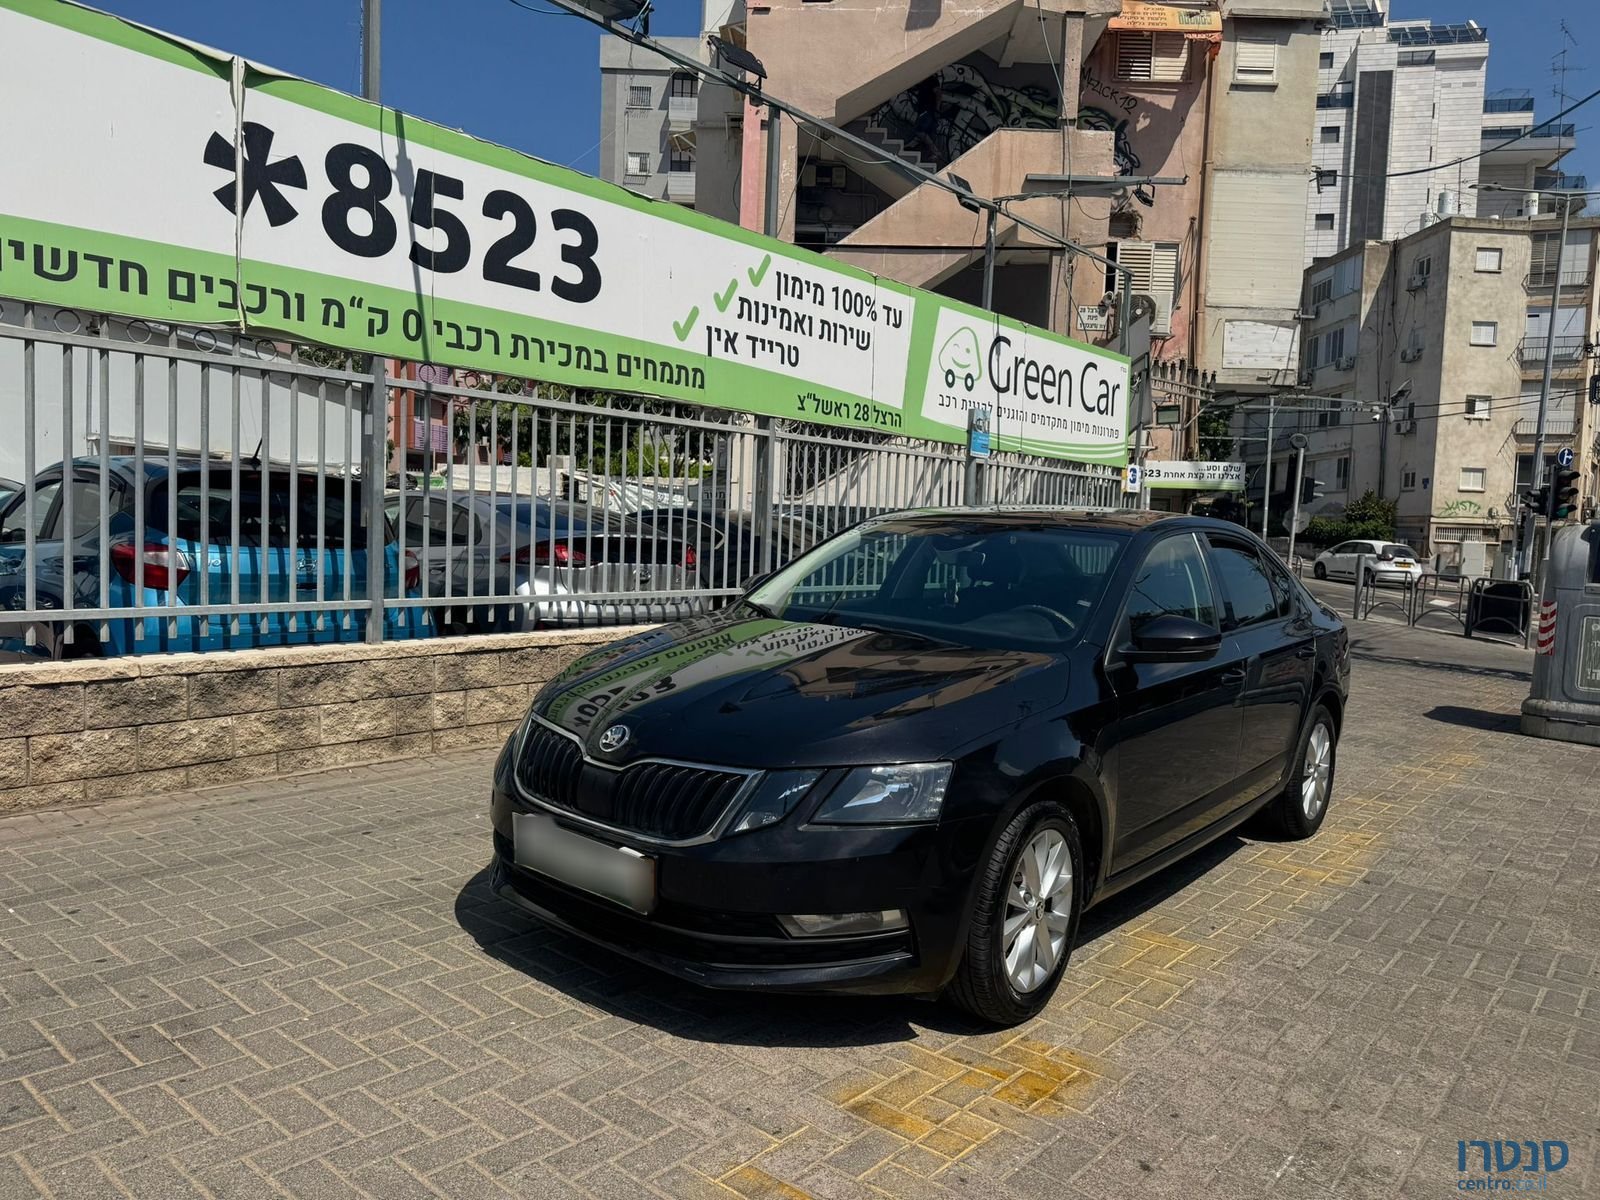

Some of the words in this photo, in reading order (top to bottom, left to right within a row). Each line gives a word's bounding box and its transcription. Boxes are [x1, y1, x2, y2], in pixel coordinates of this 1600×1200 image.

[0, 238, 148, 296] חדשי
[168, 268, 305, 322] ורכבים
[775, 271, 825, 307] מימון
[832, 285, 877, 322] 100%
[402, 308, 423, 342] 0
[737, 296, 813, 337] ואמינות
[882, 304, 903, 329] עד
[433, 319, 501, 356] רכבי
[706, 325, 739, 357] אין
[746, 334, 800, 367] טרייד
[818, 318, 871, 351] שירות
[510, 333, 609, 374] במכירת
[617, 352, 706, 390] מתמחים
[988, 335, 1073, 407] Green
[1080, 361, 1121, 417] Car
[854, 402, 870, 422] 28
[873, 405, 902, 428] הרצל
[938, 394, 957, 409] רכב
[997, 406, 1028, 422] והוגנים
[1031, 412, 1068, 430] מתקדמים
[1070, 420, 1090, 434] מימון
[1092, 425, 1120, 439] פתרונות
[1164, 471, 1186, 479] אחרת
[1188, 471, 1205, 481] קצת
[1223, 464, 1241, 472] שלם
